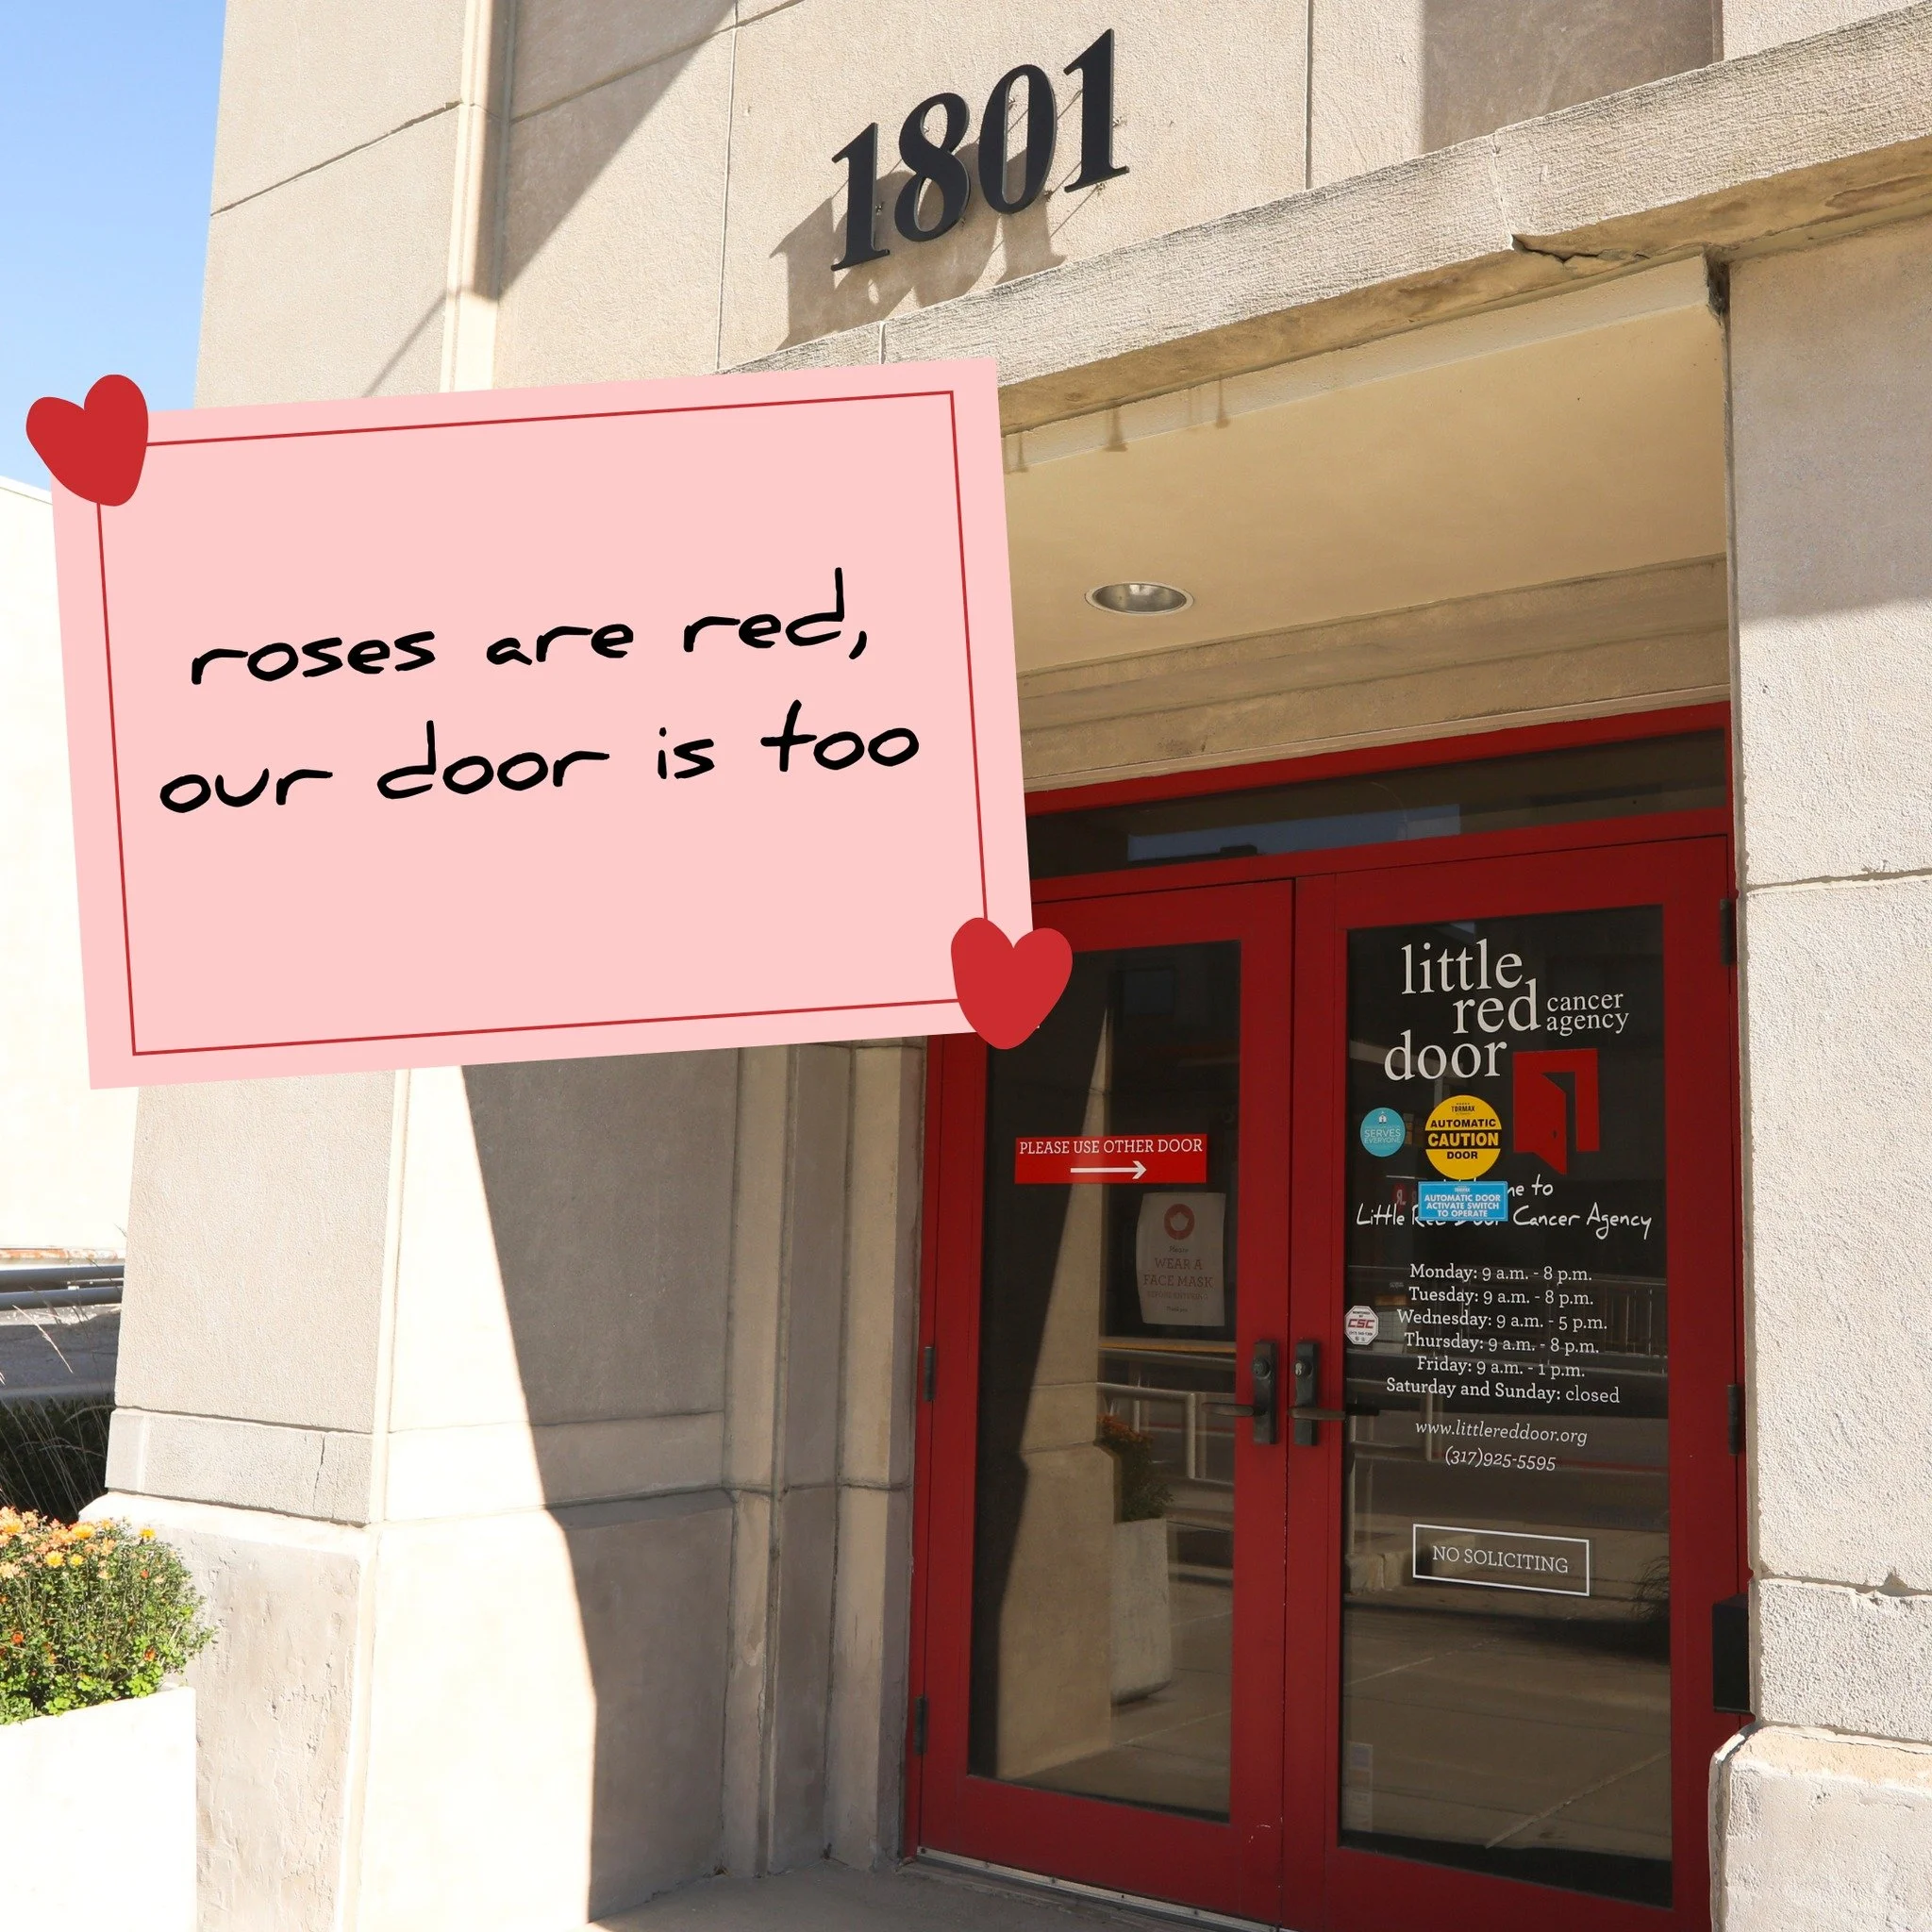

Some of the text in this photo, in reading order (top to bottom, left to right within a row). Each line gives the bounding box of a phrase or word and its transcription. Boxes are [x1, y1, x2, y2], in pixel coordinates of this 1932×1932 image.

[830, 28, 1129, 271] 1801
[1402, 938, 1523, 994] little
[1453, 978, 1541, 1034] red
[1547, 993, 1624, 1011] cancer
[1546, 1012, 1629, 1036] agency
[1385, 1029, 1507, 1080] door
[1364, 1129, 1401, 1138] SERVES
[1430, 1119, 1496, 1127] AUTOMATIC
[1020, 1139, 1203, 1154] PLEASE USE OTHER DOOR
[1428, 1133, 1498, 1146] CAUTION
[1447, 1151, 1478, 1159] DOOR
[1532, 1174, 1554, 1196] to
[1357, 1203, 1405, 1225] Little
[1513, 1206, 1580, 1226] Cancer
[1587, 1203, 1651, 1240] Agency
[1155, 1257, 1203, 1270] WEAR A
[1409, 1263, 1477, 1282] Monday:
[1482, 1268, 1491, 1281] 9
[1497, 1270, 1529, 1280] a.m.
[1543, 1267, 1553, 1280] 8
[1557, 1271, 1591, 1285] p.m.
[1143, 1274, 1214, 1288] FACE MASK
[1409, 1287, 1478, 1306] Tuesday:
[1483, 1291, 1492, 1305] 9
[1498, 1293, 1530, 1304] a.m.
[1545, 1291, 1555, 1304] 8
[1559, 1294, 1593, 1308] p.m.
[1348, 1319, 1374, 1328] CSC
[1397, 1309, 1491, 1329] Wednesday:
[1497, 1315, 1506, 1328] 9
[1511, 1318, 1543, 1327] a.m.
[1558, 1316, 1567, 1331] 5
[1573, 1319, 1607, 1332] p.m.
[1405, 1333, 1483, 1351] Thursday:
[1489, 1340, 1497, 1352] 9
[1502, 1341, 1535, 1351] a.m.
[1550, 1339, 1559, 1352] 8
[1565, 1342, 1599, 1357] p.m.
[1417, 1357, 1472, 1374] Friday:
[1476, 1361, 1486, 1375] 9
[1491, 1364, 1524, 1374] a.m.
[1539, 1363, 1545, 1375] 1
[1551, 1366, 1585, 1379] p.m.
[1387, 1377, 1620, 1403] Saturday and Sunday: closed
[1415, 1421, 1588, 1446] www.littlereddoor.org
[1445, 1446, 1556, 1471] (317)925-5595
[1433, 1546, 1568, 1574] NO SOLICITING
